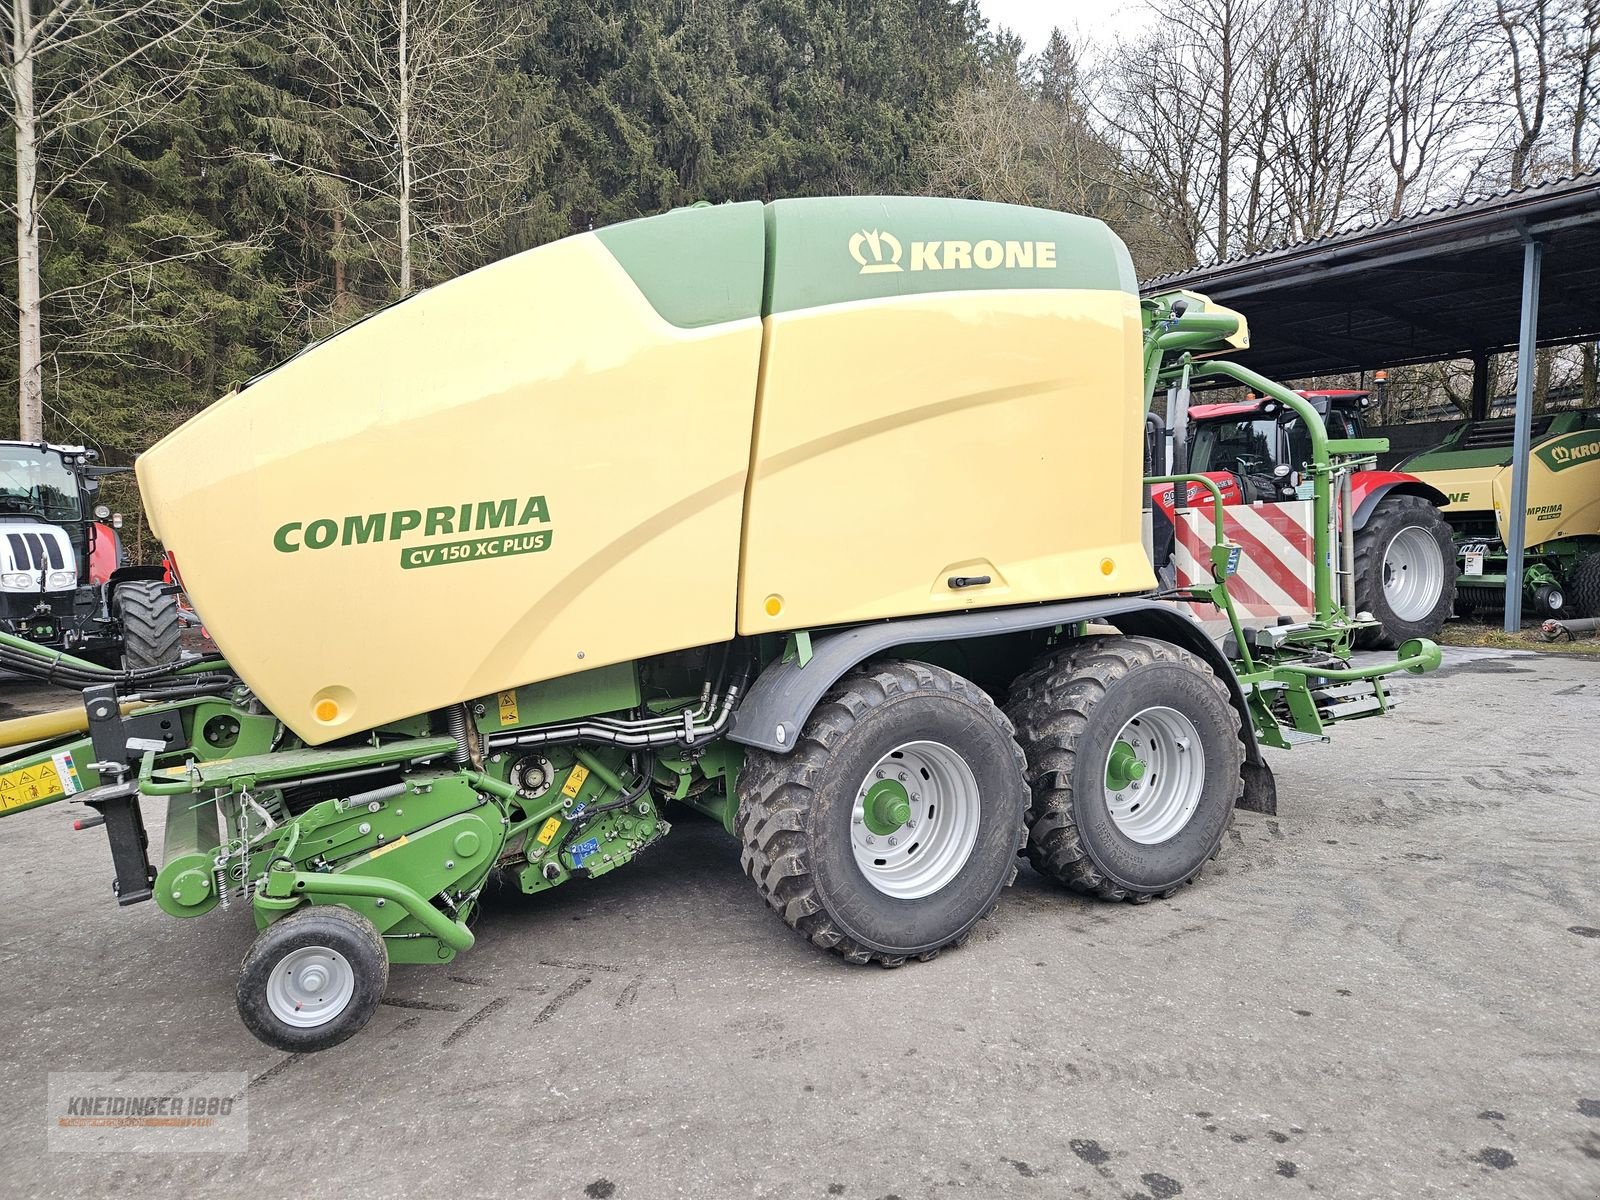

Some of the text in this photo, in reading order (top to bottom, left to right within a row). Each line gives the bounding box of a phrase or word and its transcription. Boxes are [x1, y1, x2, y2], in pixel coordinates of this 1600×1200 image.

[910, 239, 1057, 271] KRONE
[1570, 441, 1600, 460] KRO
[273, 495, 551, 553] COMPRIMA
[1526, 504, 1563, 516] MPRIMA
[410, 535, 544, 565] CV 150 XC PLUS
